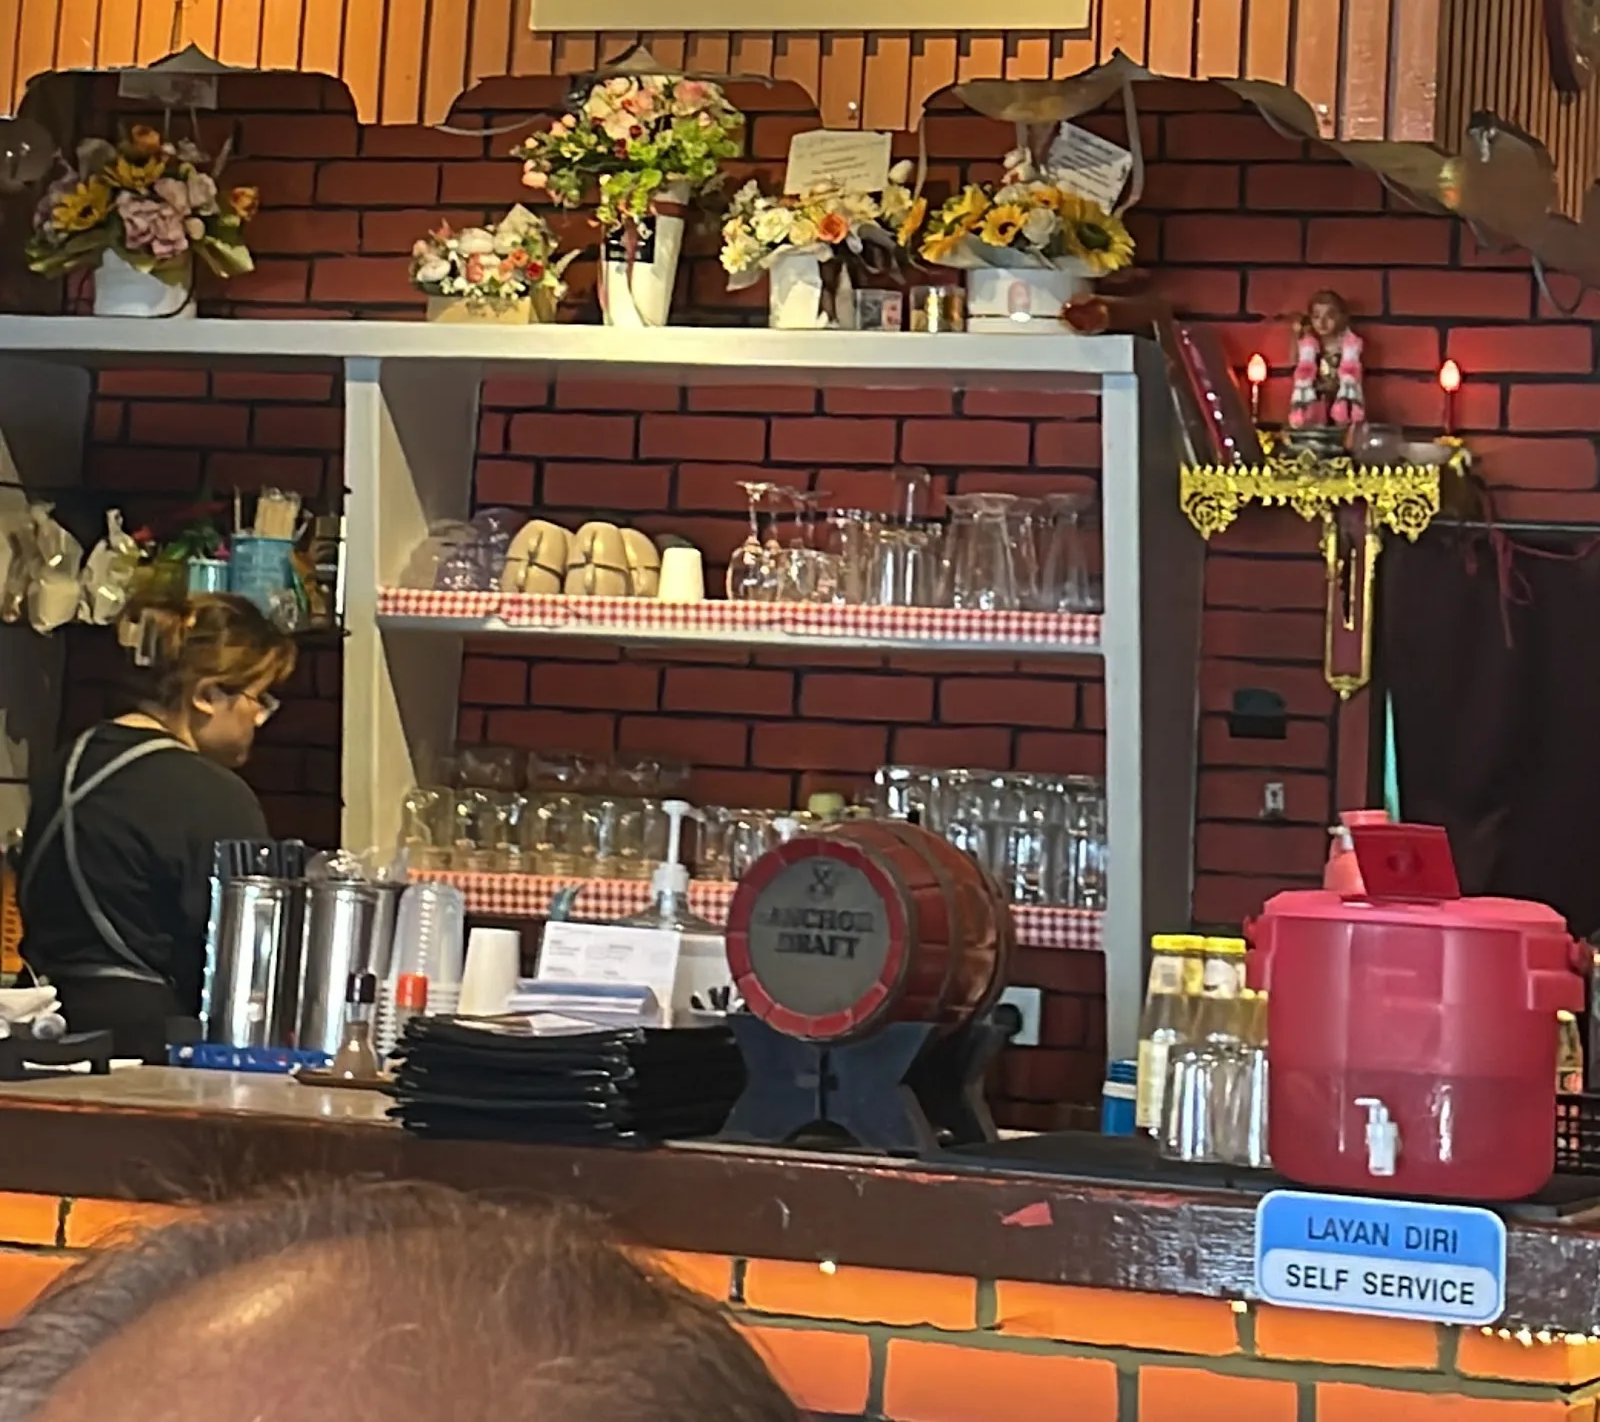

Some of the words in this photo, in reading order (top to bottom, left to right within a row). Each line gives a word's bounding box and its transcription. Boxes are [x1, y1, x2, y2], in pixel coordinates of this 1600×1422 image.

[1307, 1216, 1389, 1247] LAYAN
[1405, 1225, 1458, 1255] DIRI
[1285, 1263, 1349, 1292] SELF
[1362, 1271, 1475, 1306] SERVICE
